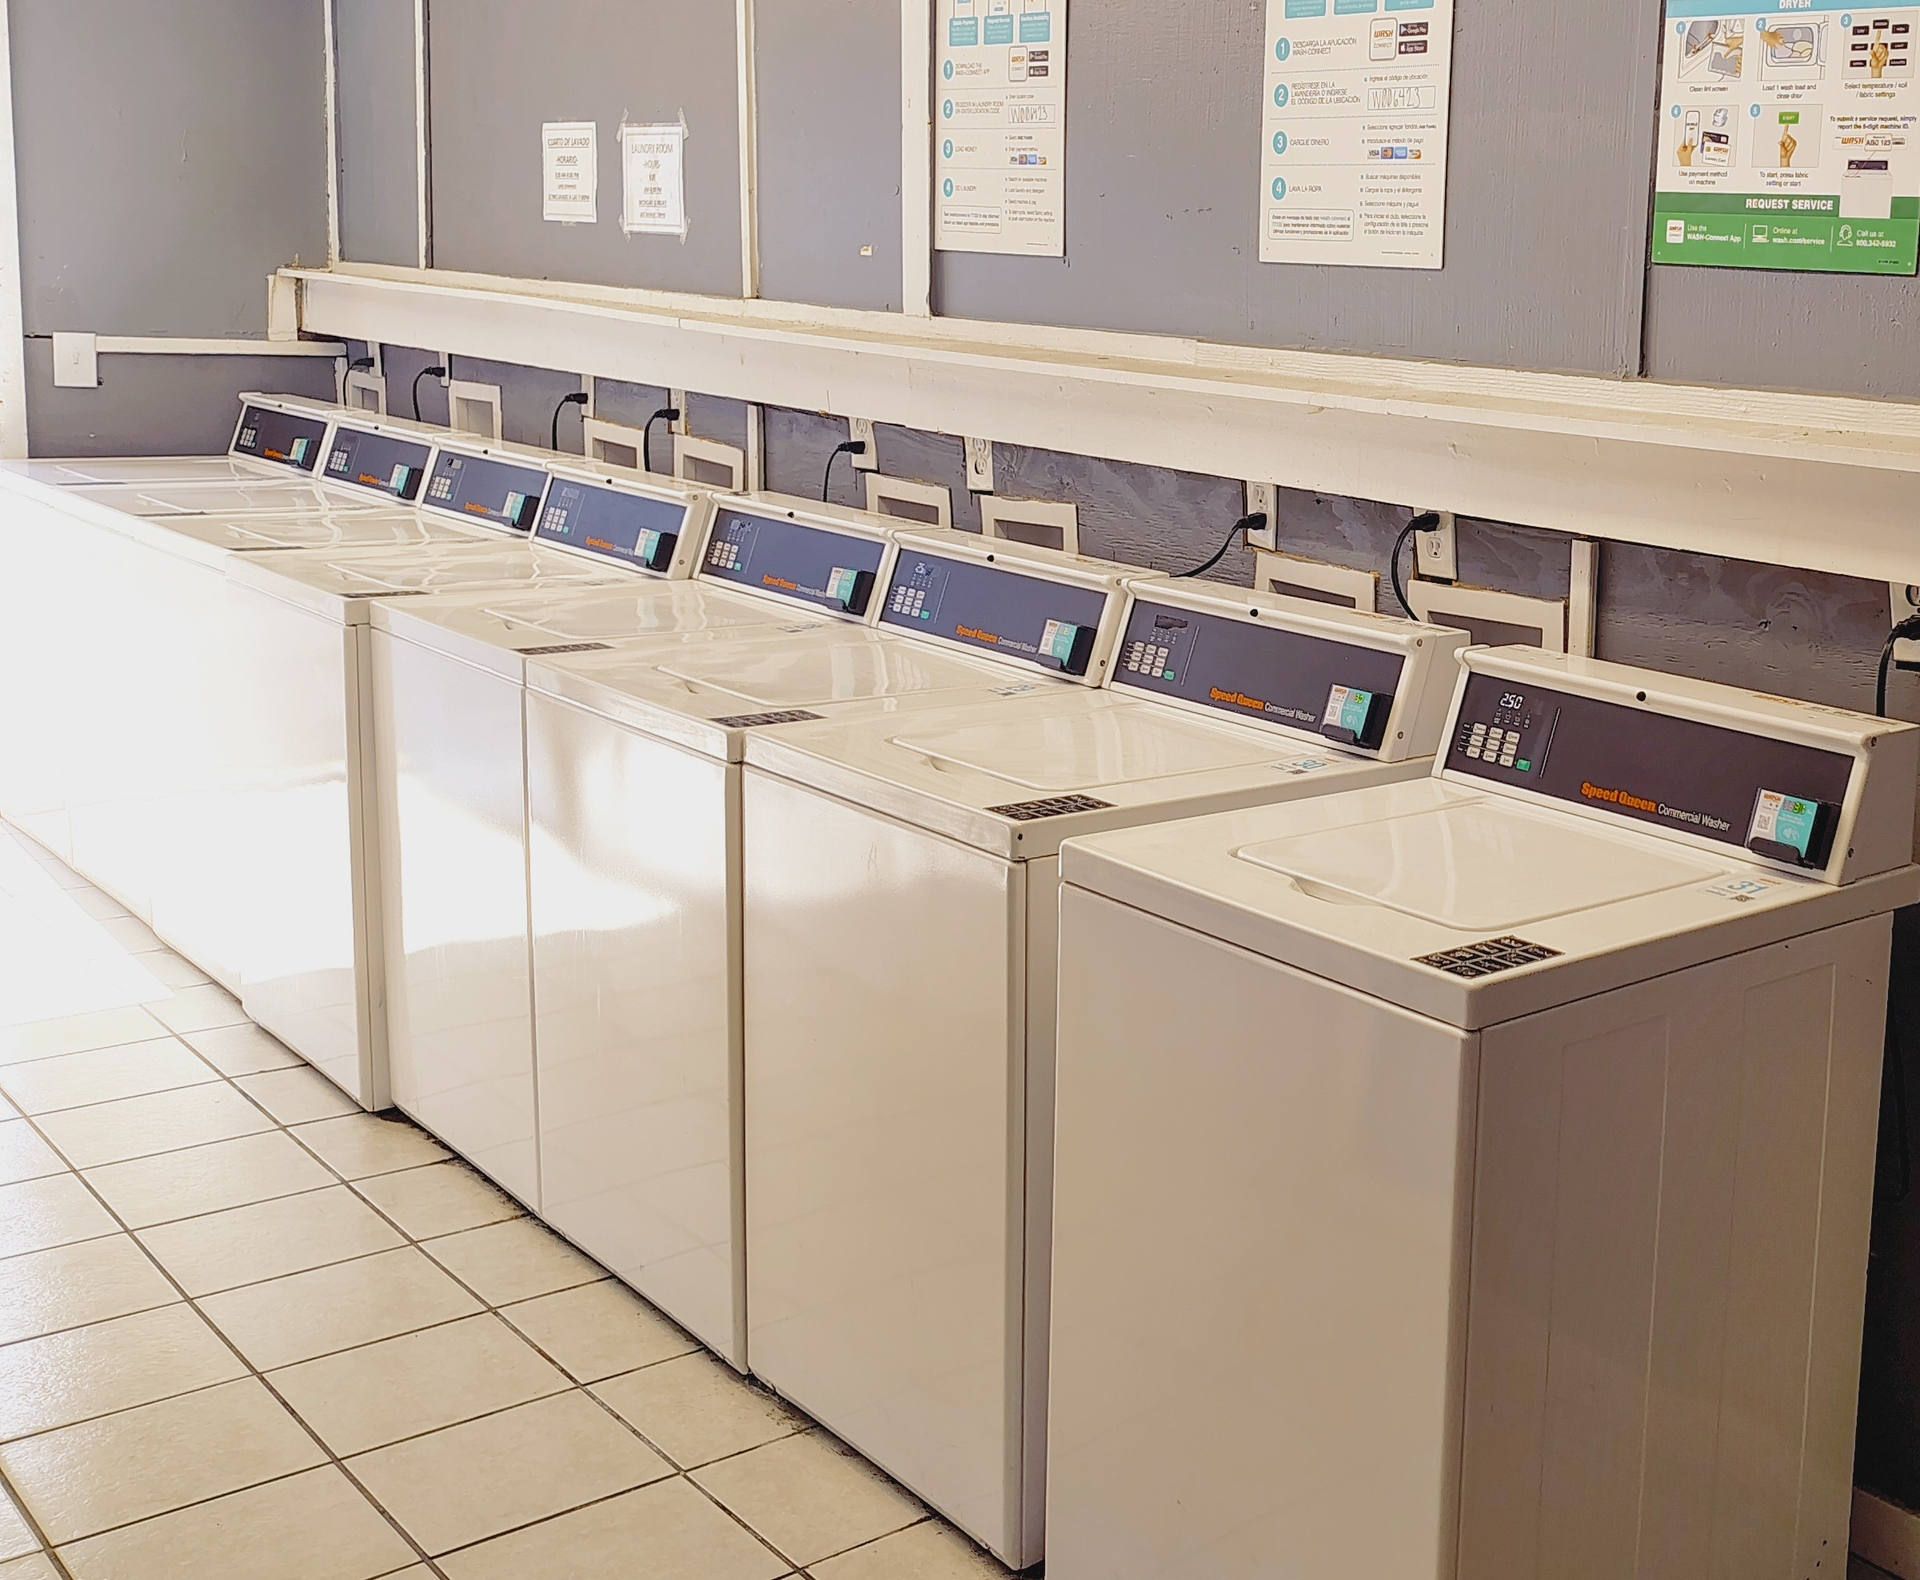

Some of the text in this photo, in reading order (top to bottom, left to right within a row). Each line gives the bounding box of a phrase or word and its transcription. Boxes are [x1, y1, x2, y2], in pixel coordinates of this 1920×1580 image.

[1779, 0, 1811, 9] DRYER
[1293, 40, 1319, 48] DESCARGA
[1278, 91, 1284, 101] 2
[1278, 136, 1283, 148] 3
[631, 144, 674, 153] LAUNDRY ROOM
[1276, 182, 1282, 194] 4
[1746, 199, 1833, 210] REQUEST SERVICE
[1687, 233, 1729, 241] WASH-Connect
[1730, 234, 1742, 243] App
[1773, 237, 1825, 245] wash.com/service
[956, 625, 977, 637] Speed
[977, 629, 998, 644] Queen
[1210, 687, 1316, 722] Speed Queen Commercial Washer
[1581, 782, 1731, 831] Speed Queen Commercial Washer
[1727, 881, 1769, 894] 31
